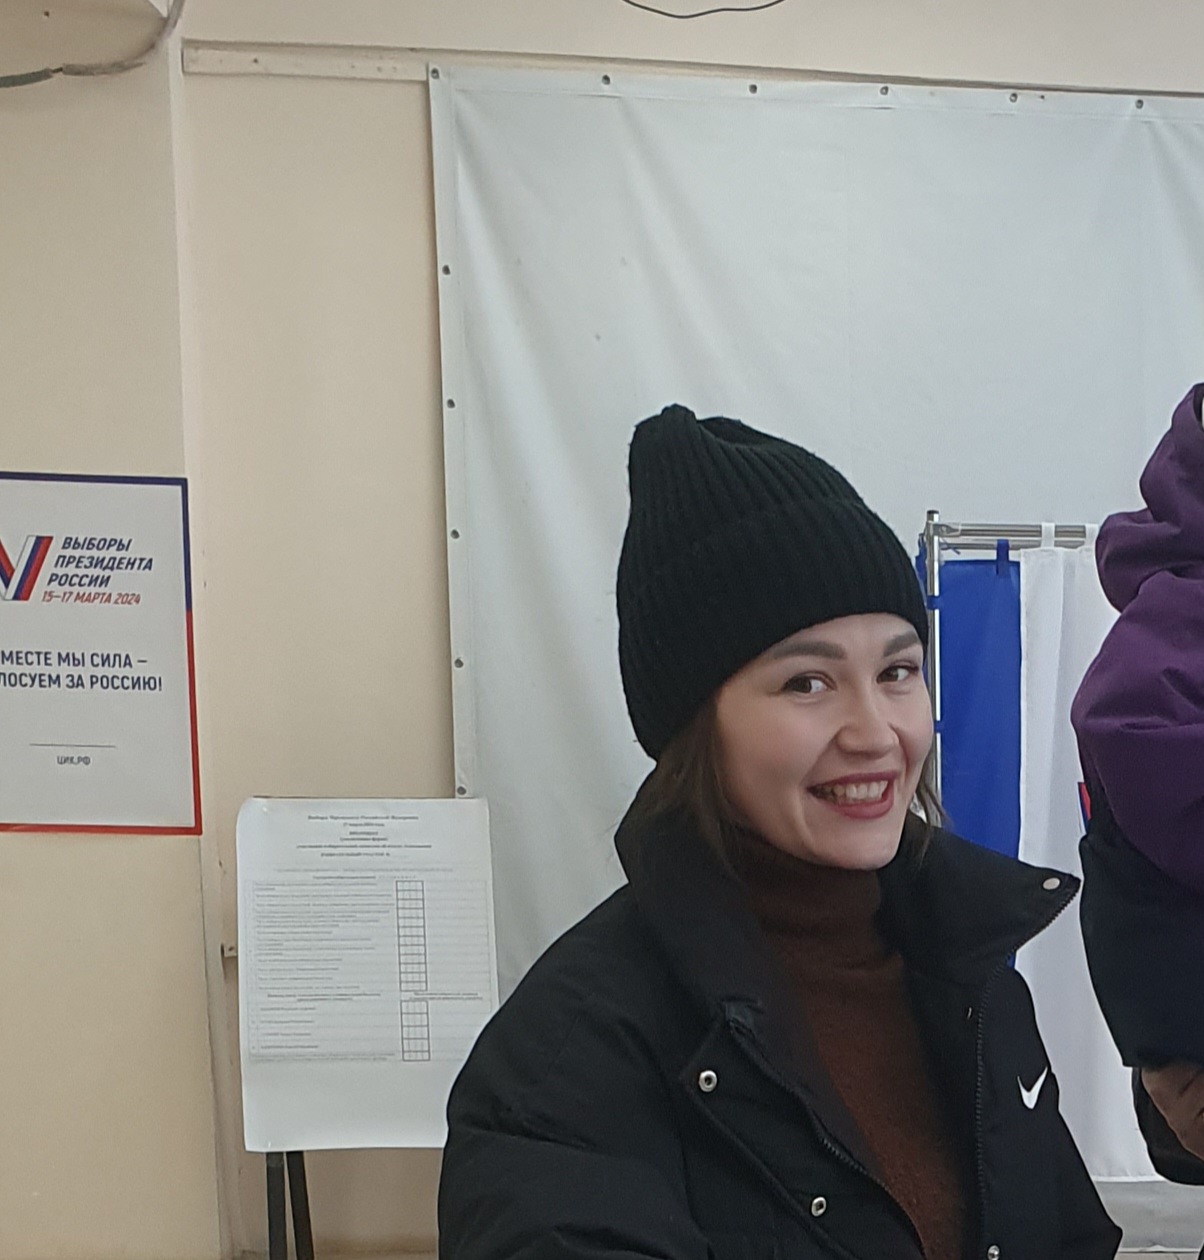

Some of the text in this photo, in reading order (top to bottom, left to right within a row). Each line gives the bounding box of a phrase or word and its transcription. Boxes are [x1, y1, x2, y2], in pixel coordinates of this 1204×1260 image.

[61, 536, 132, 552] ВЫБОРЫ
[54, 554, 153, 571] ПРЕЗИДЕНТА
[47, 573, 111, 588] РОССИИ
[74, 591, 112, 604] МАРТА
[114, 593, 141, 605] 2024
[57, 651, 85, 667] МЫ
[90, 652, 133, 668] СИЛА
[66, 673, 85, 689] ЗА
[90, 674, 162, 691] РОССИЮ!
